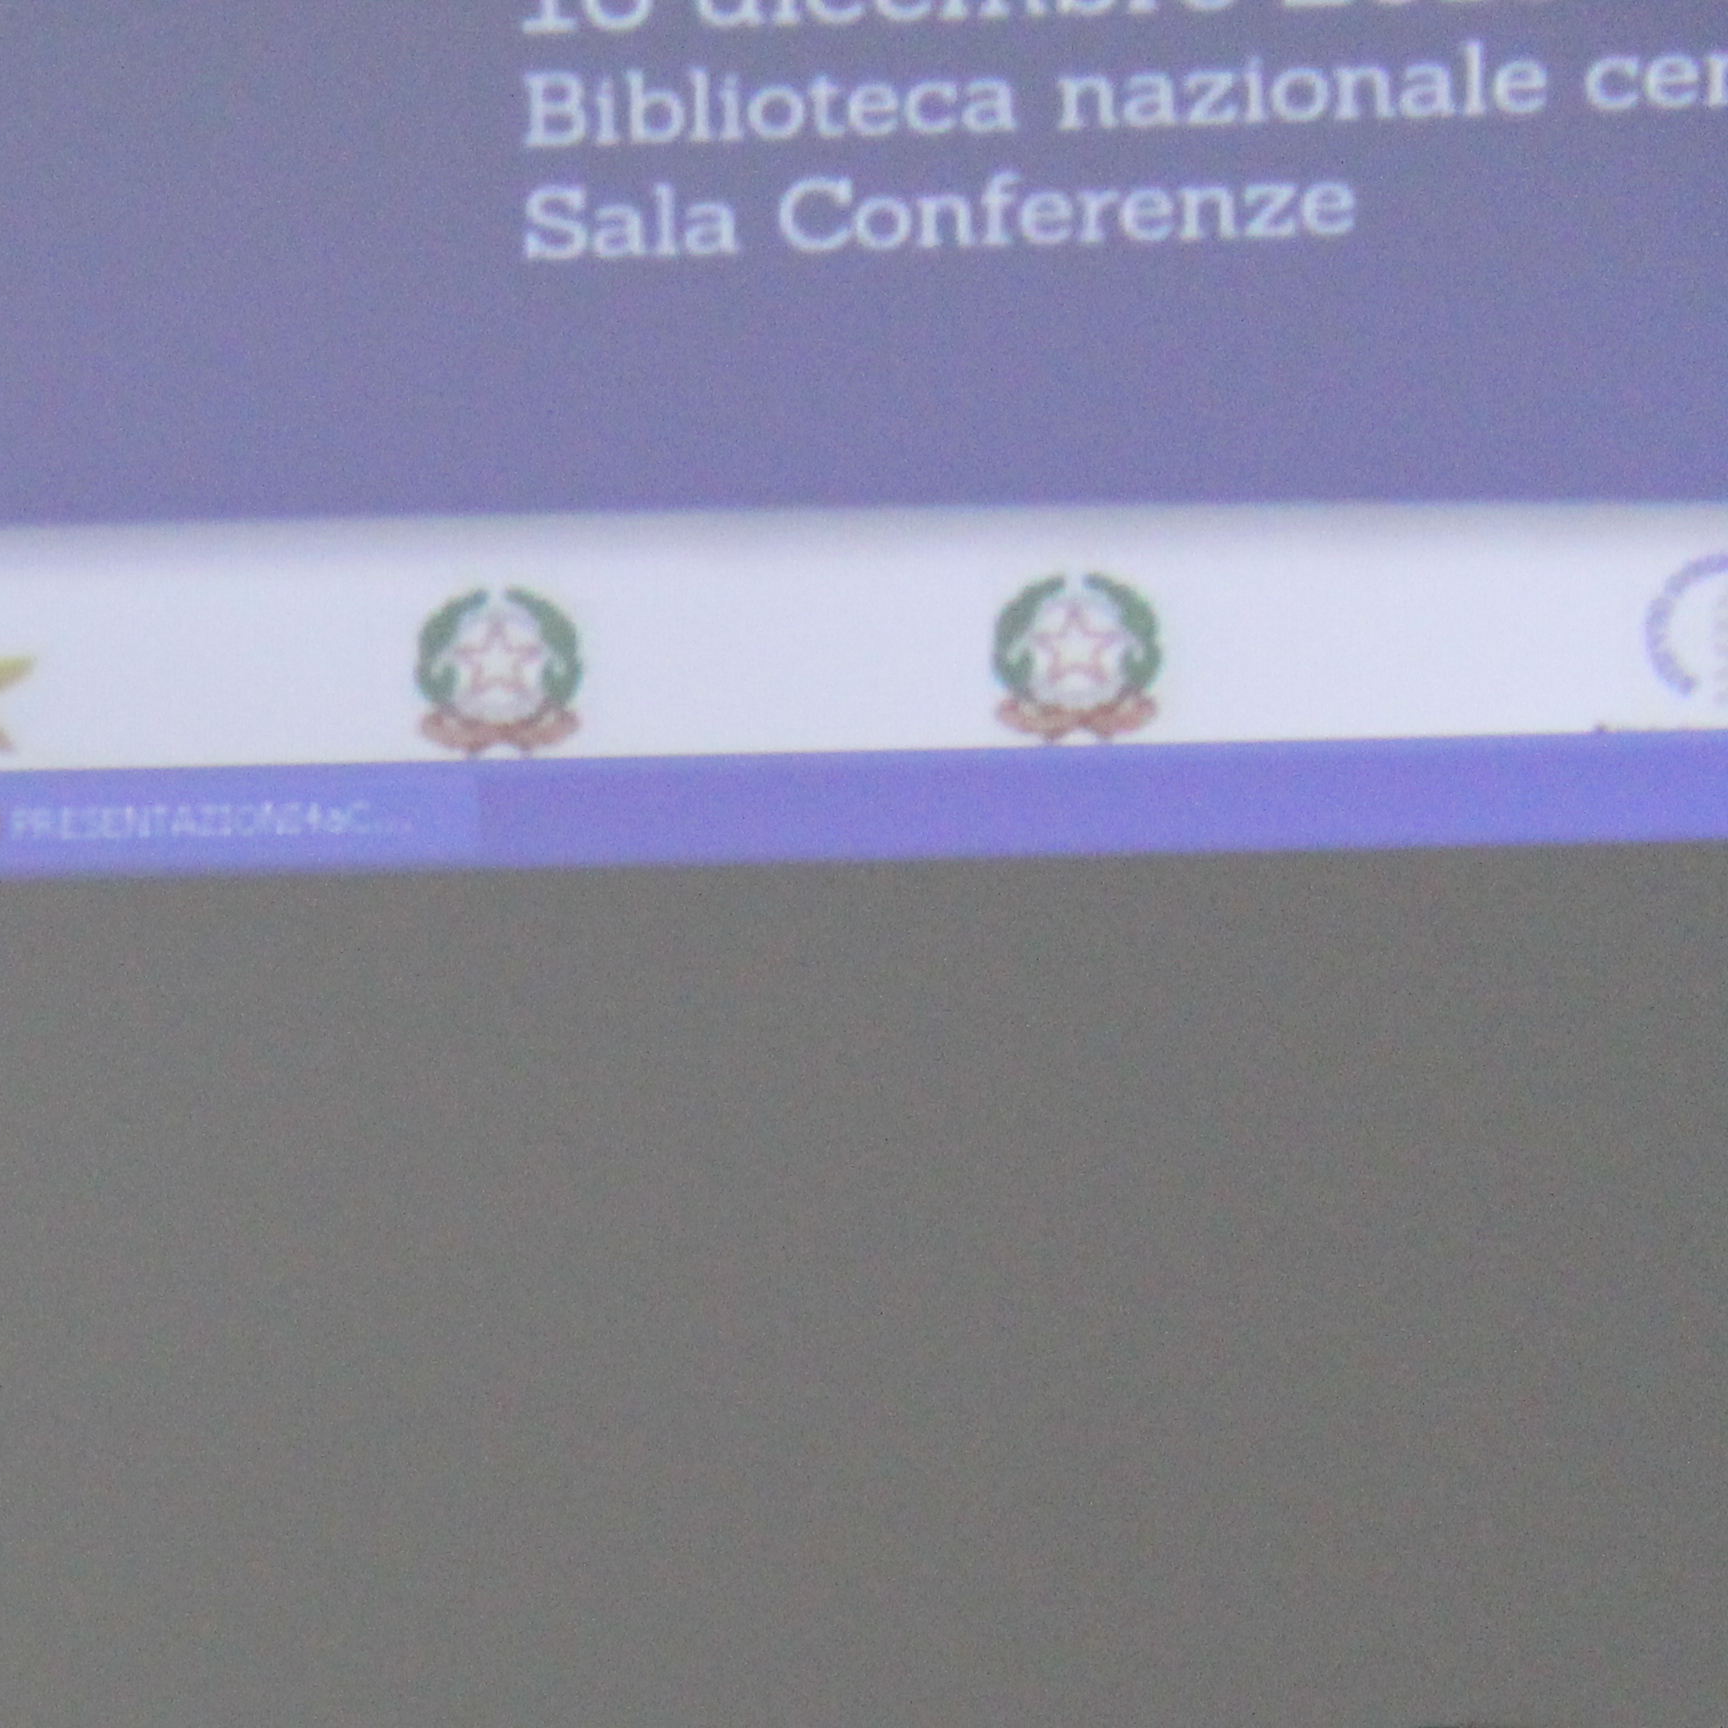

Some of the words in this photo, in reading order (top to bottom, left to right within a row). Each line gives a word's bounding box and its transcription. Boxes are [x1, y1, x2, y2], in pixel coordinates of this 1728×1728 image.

[522, 68, 1017, 148] Biblioteca
[1056, 38, 1548, 131] nazionale
[522, 180, 740, 261] Sala
[777, 167, 1358, 253] Conferenze
